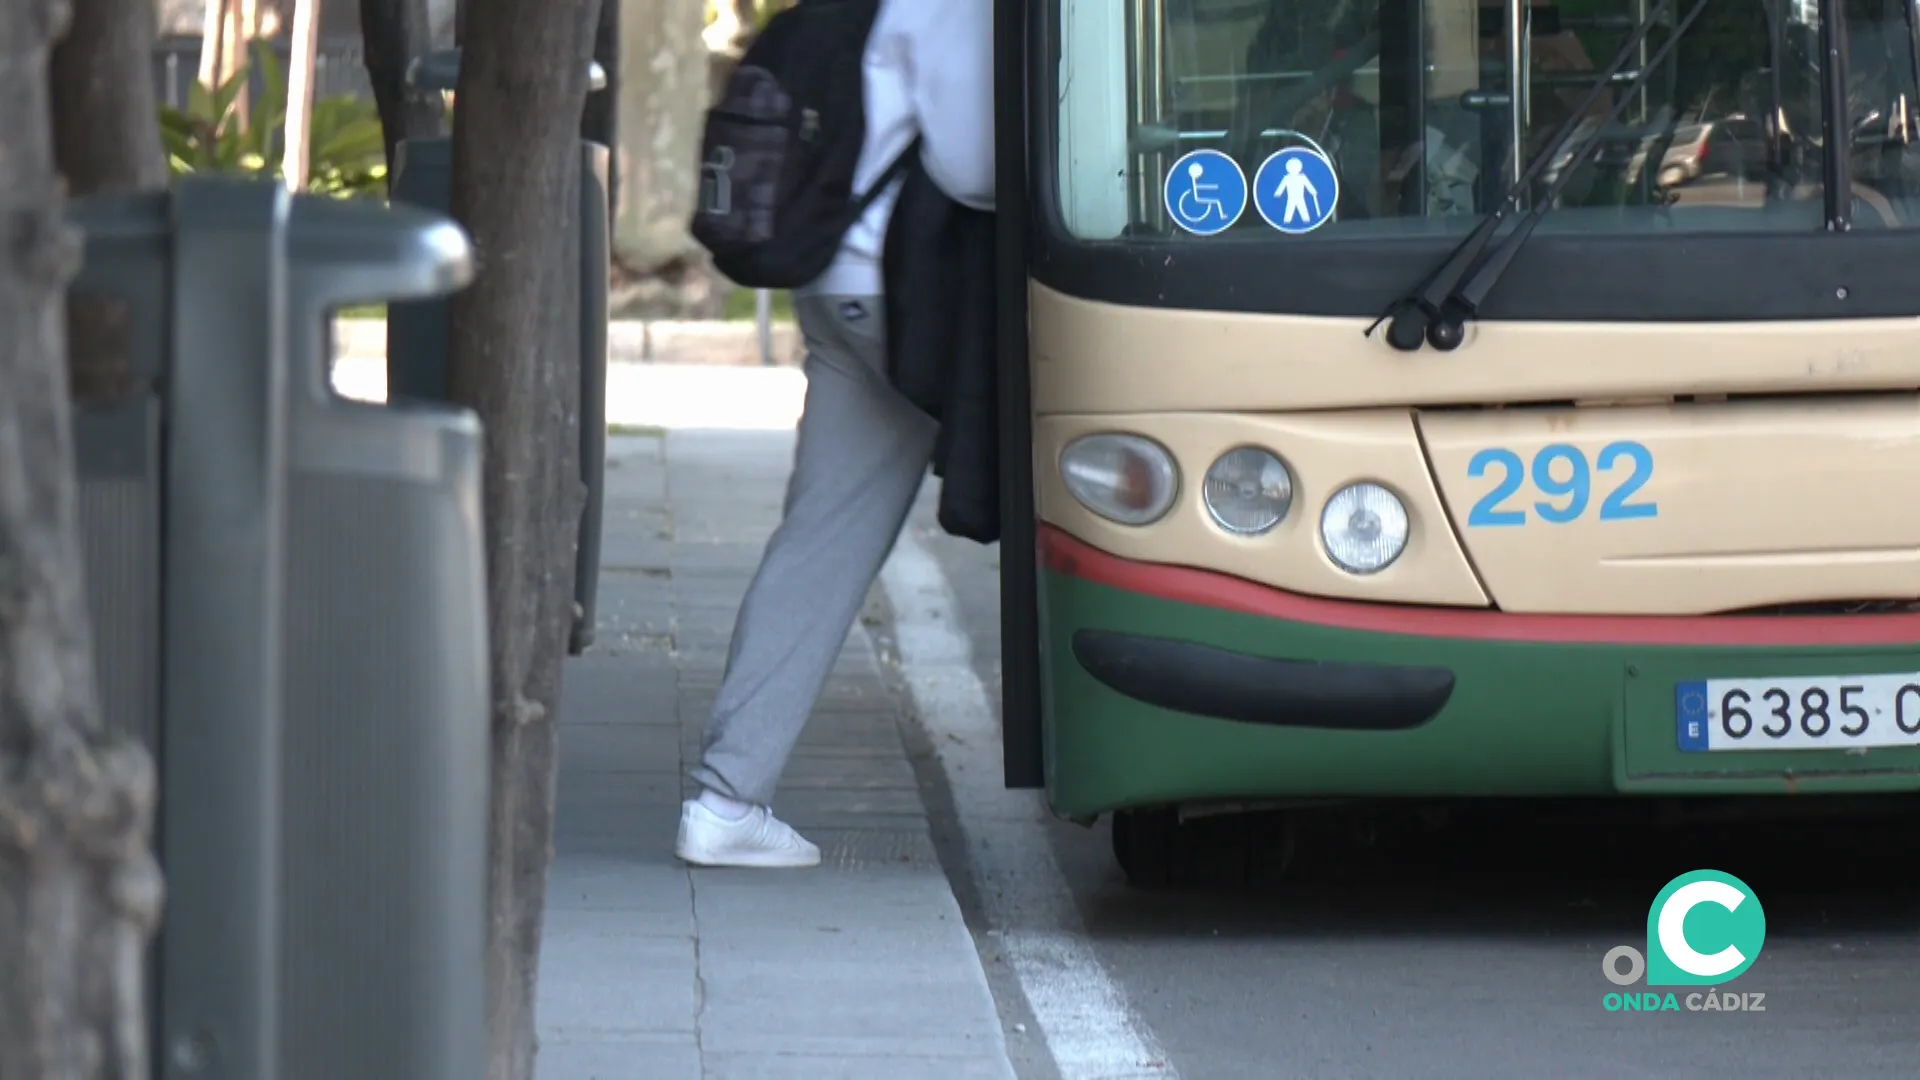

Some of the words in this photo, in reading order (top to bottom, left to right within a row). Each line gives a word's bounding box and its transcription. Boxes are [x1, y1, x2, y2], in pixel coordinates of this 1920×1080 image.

[1467, 440, 1658, 527] 292
[1688, 720, 1700, 738] E
[1721, 686, 1870, 739] 6385
